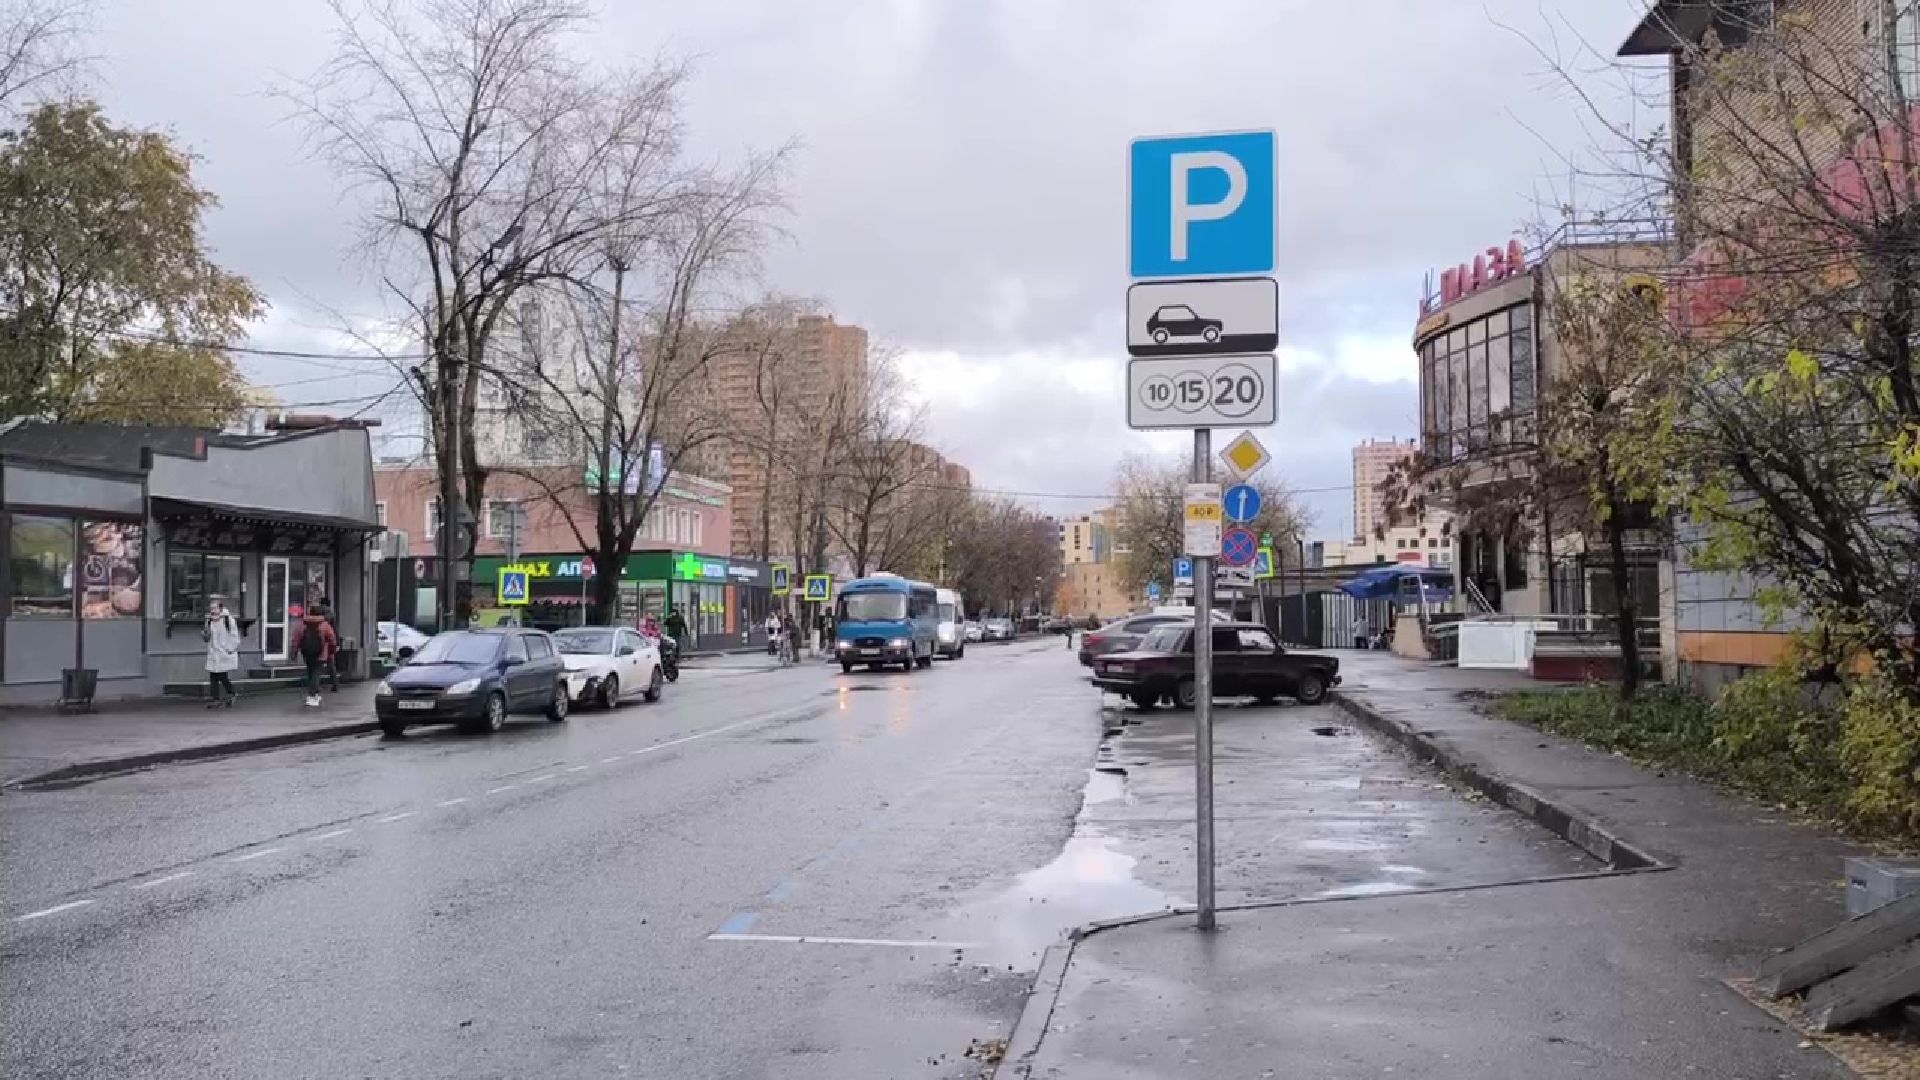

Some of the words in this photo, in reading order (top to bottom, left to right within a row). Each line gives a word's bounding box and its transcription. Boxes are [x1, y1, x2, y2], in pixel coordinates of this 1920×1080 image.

[1170, 150, 1248, 262] P
[1148, 383, 1170, 402] 10
[1177, 380, 1204, 404] 15
[1215, 375, 1257, 406] 20
[1179, 561, 1189, 576] P
